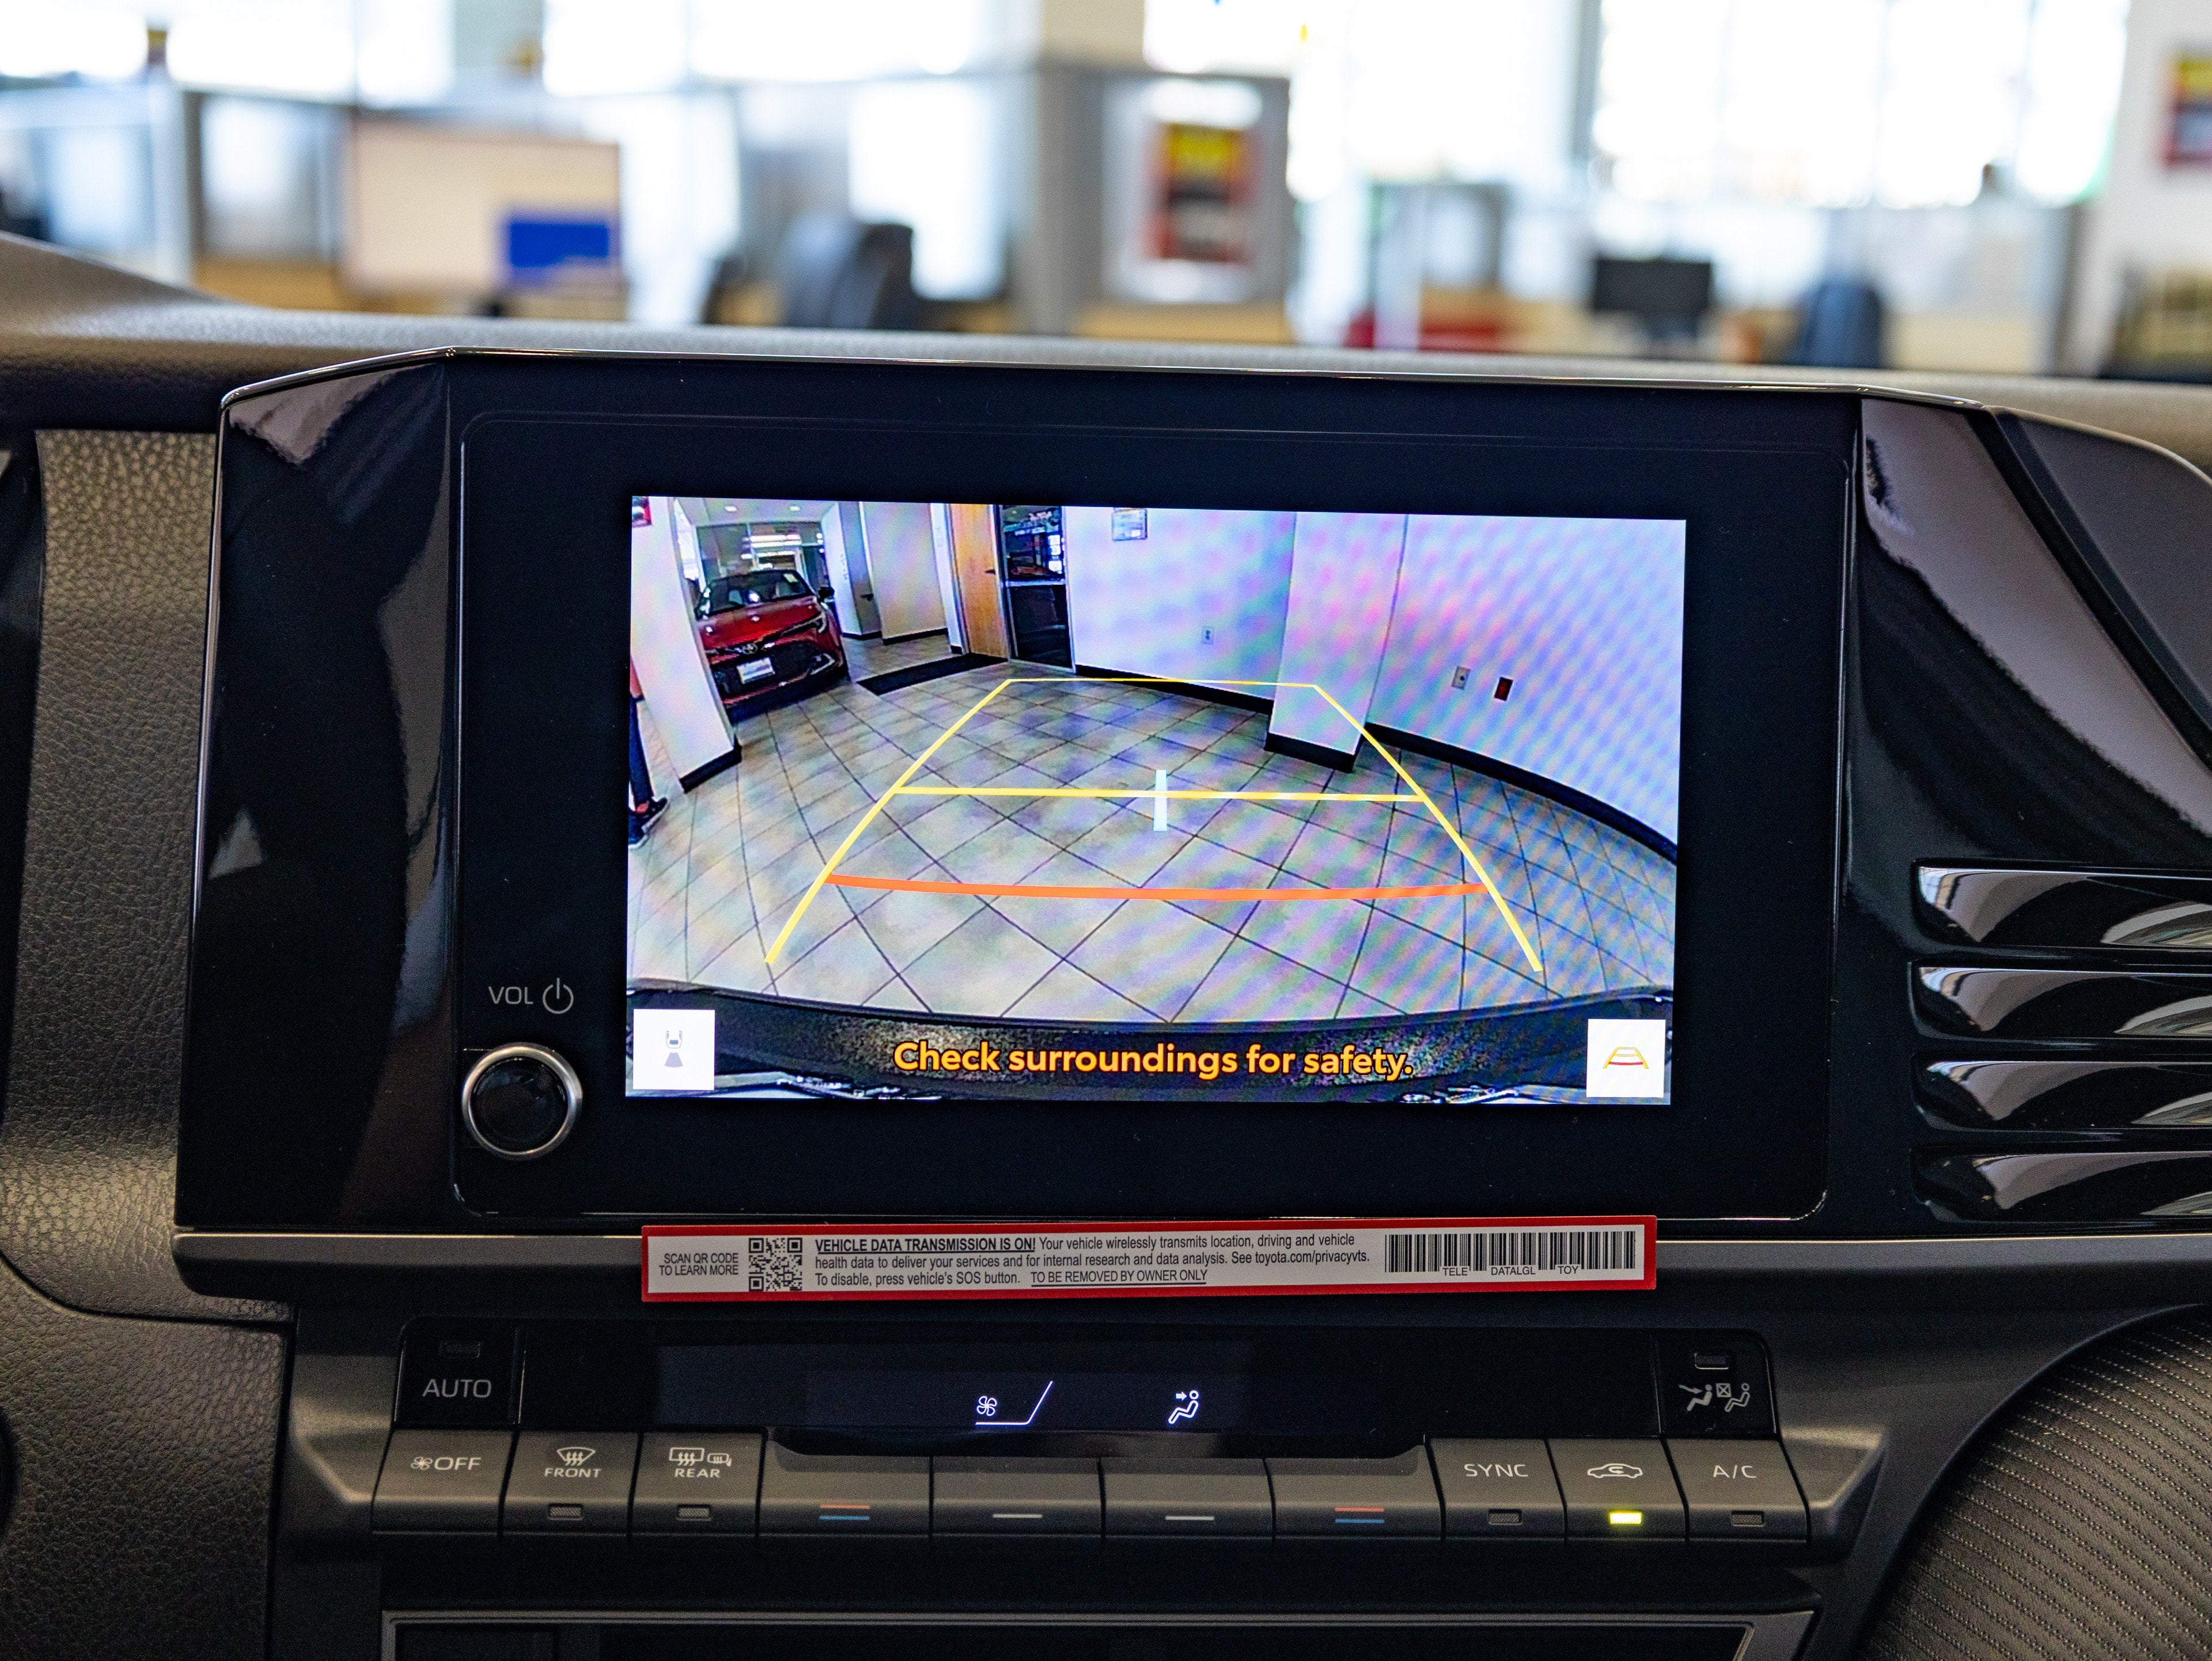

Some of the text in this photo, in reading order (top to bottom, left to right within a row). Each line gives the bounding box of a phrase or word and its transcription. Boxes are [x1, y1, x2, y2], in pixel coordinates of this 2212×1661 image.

[488, 986, 533, 1004] VOL
[893, 1040, 1414, 1081] Check surroundings for safety.
[815, 1234, 1354, 1252] VEHICLE DATA TRANSMISSION IS ON! Your vehicle wirelessly transmits location, driving and vehicle
[664, 1253, 738, 1264] SCAN QR CODE
[815, 1250, 1370, 1270] health data to deliver your services and for internal research and data analysis. See toyota.com/privacyvts.
[659, 1265, 738, 1276] TO LEARN MORE
[815, 1269, 1207, 1287] To disable, press vehicle's SOS button. TO BE REMOVED BY OWNER ONLY
[1442, 1266, 1579, 1276] TELE DATALGL TOY
[422, 1379, 492, 1398] AUTO
[434, 1456, 482, 1471] OFF
[1464, 1463, 1528, 1478] SYNC
[544, 1467, 601, 1478] FRONT
[675, 1467, 720, 1478] REAR
[1712, 1464, 1757, 1479] A/C
